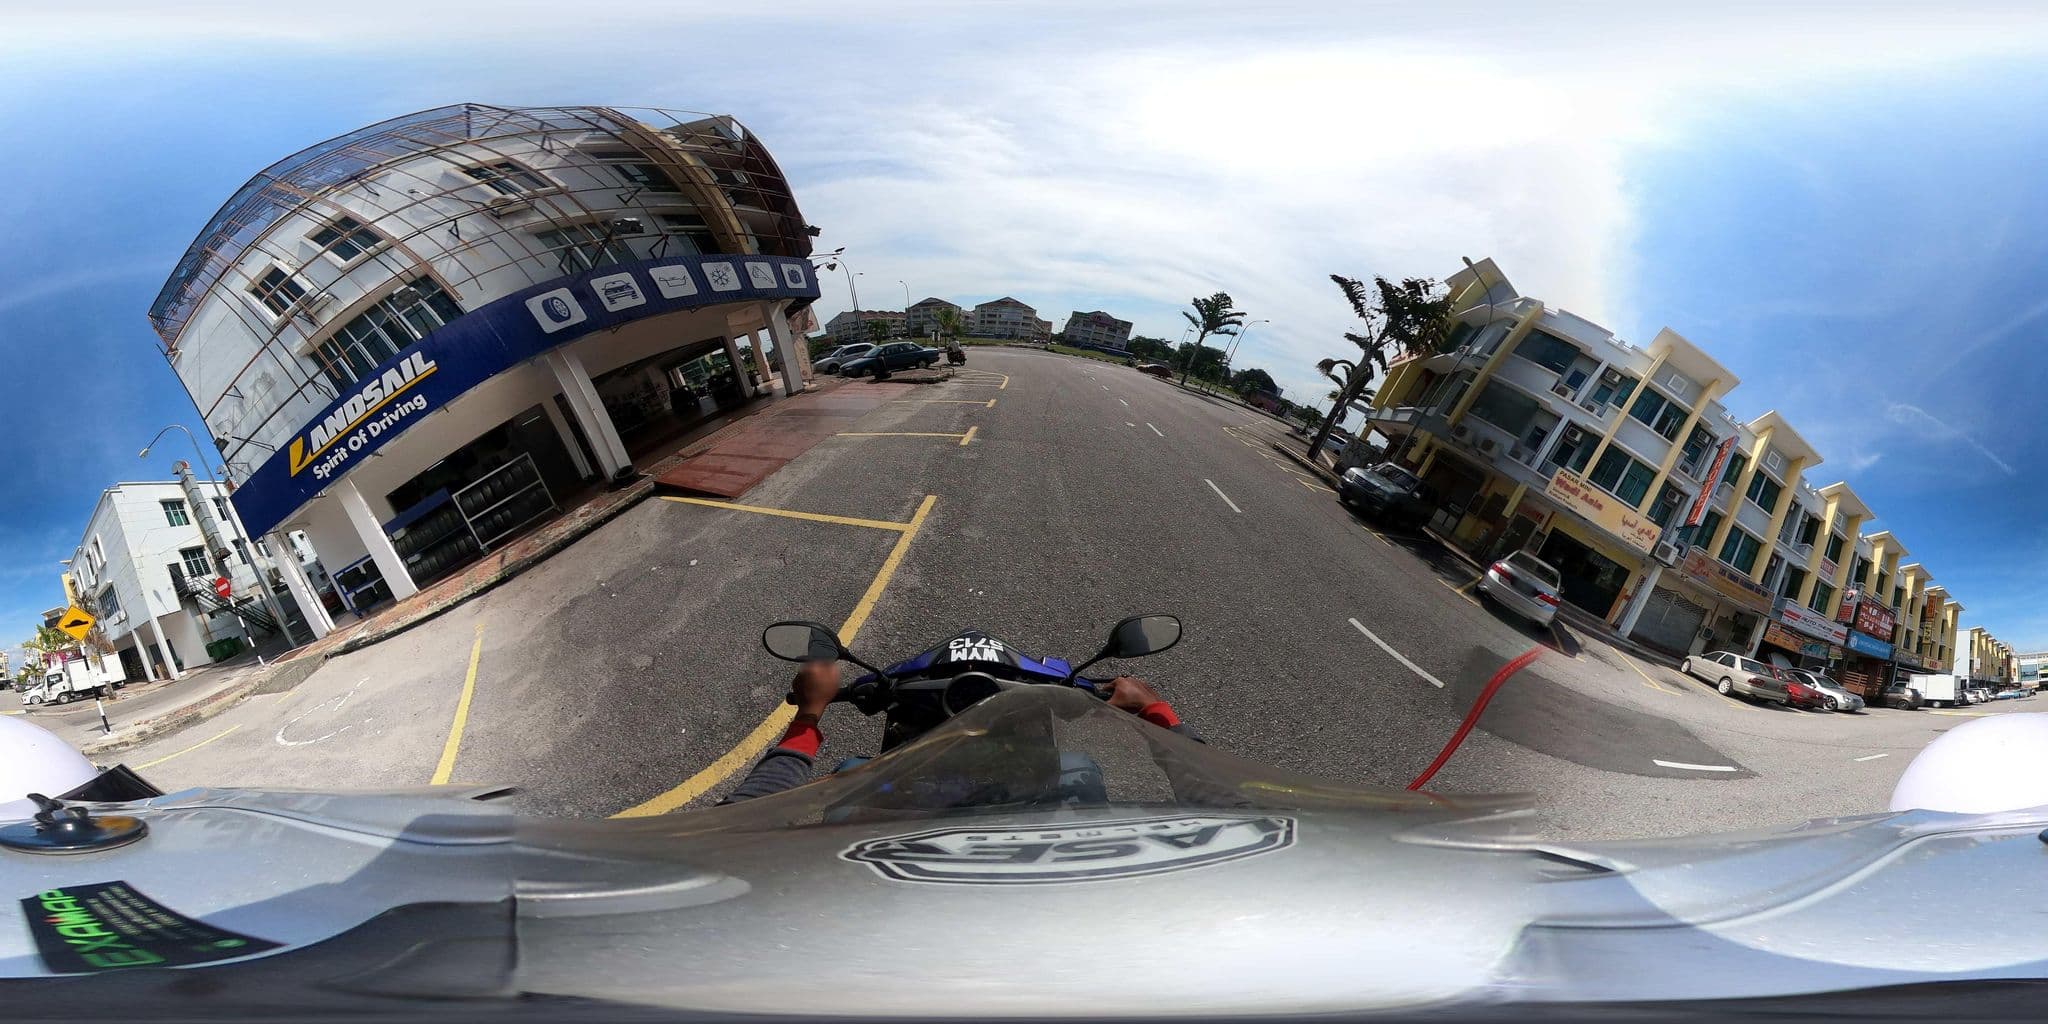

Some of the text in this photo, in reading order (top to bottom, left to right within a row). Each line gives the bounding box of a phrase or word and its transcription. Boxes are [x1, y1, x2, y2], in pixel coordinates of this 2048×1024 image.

[289, 351, 437, 478] LANDSAIL
[313, 394, 427, 479] Spirit Of Driving
[1560, 470, 1580, 488] PASAR
[948, 637, 1004, 652] 5713
[951, 647, 1000, 662] WYM
[965, 820, 1200, 842] HELMETS
